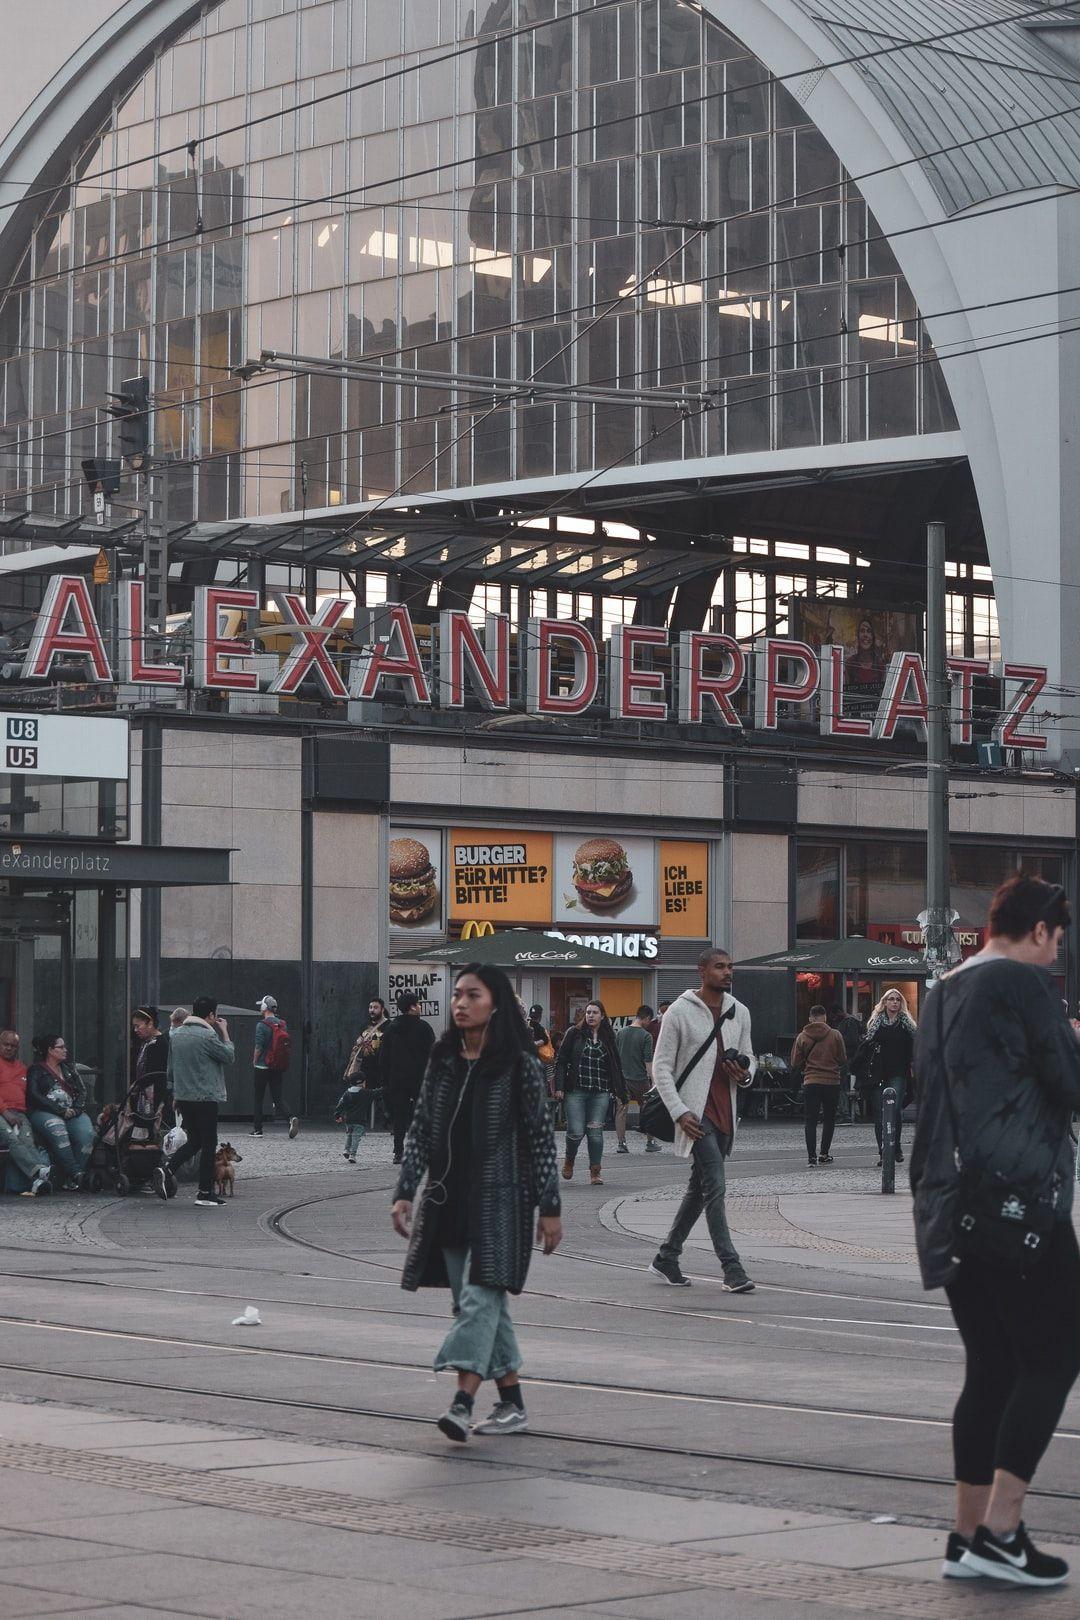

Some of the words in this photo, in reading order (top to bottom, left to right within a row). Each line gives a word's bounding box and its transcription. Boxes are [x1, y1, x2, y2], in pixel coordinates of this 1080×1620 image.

[20, 573, 1048, 752] ALEXANDERPLATZ
[10, 720, 36, 738] U8
[10, 748, 35, 767] U5
[455, 845, 525, 865] BURGER
[489, 866, 548, 884] MITTE?
[664, 866, 687, 880] ICH
[456, 885, 508, 904] BITTE!
[664, 881, 703, 896] LIEBE
[665, 898, 687, 913] ES!
[389, 973, 442, 988] SCHLAF-
[389, 988, 412, 1002] LO
